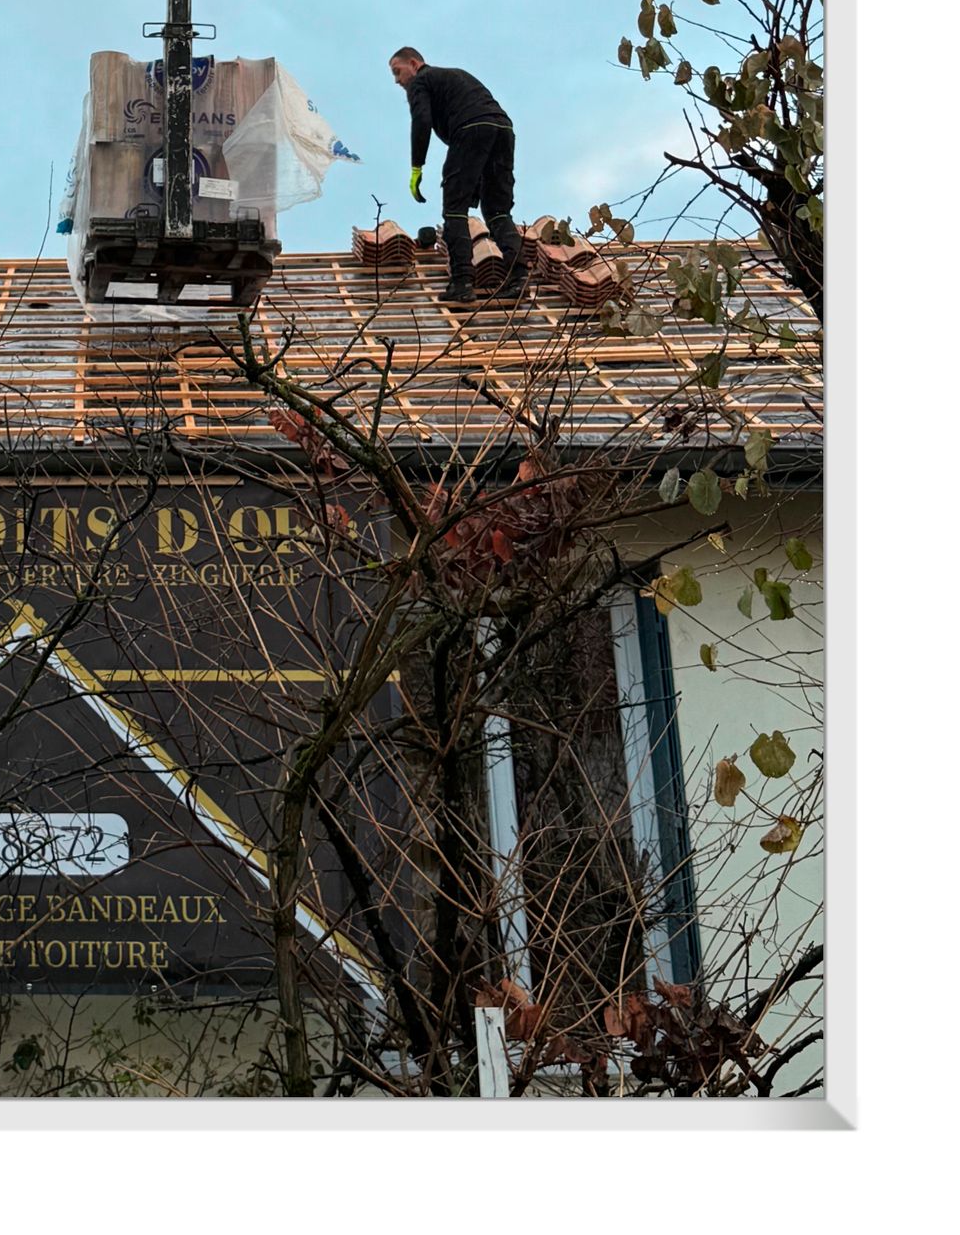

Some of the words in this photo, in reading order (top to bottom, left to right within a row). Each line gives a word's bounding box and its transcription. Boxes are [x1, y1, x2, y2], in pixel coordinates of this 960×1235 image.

[150, 112, 236, 126] EIANS
[152, 563, 304, 587] ZINGUERIE
[60, 825, 107, 863] 72
[46, 894, 228, 923] BANDEAUX
[21, 939, 170, 969] TOITURE
